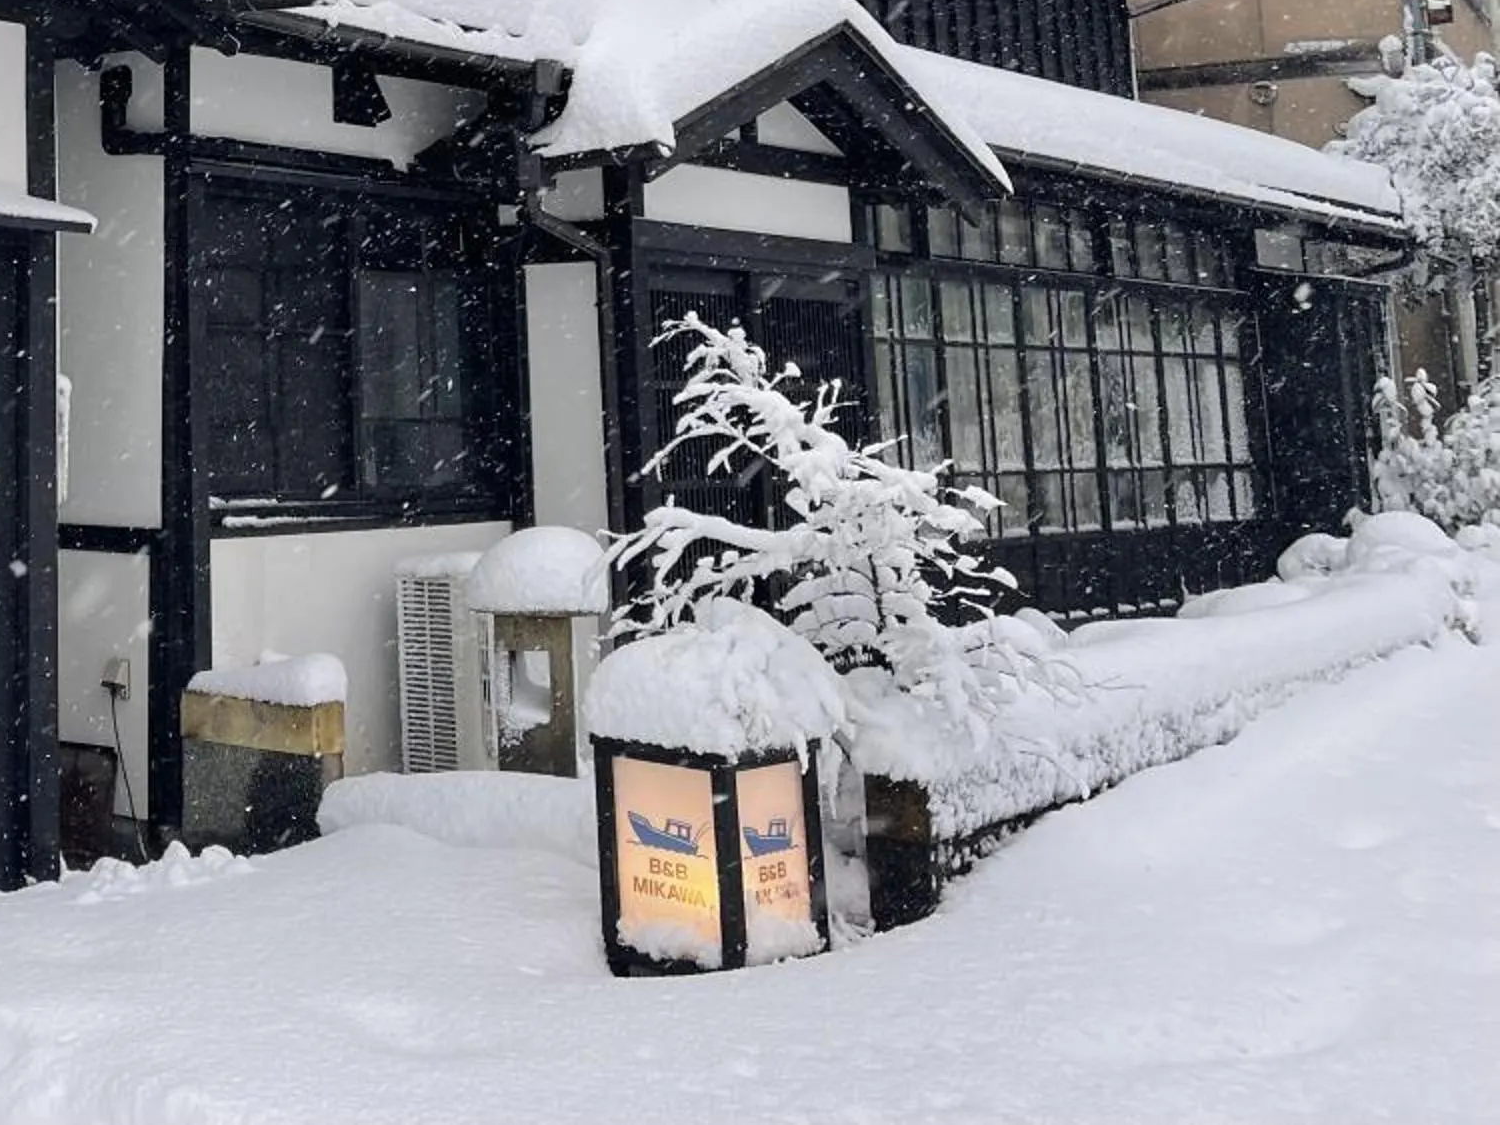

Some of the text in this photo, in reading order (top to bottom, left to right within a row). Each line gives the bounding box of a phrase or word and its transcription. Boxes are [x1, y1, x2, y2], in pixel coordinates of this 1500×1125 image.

[649, 857, 688, 880] B&B
[759, 861, 787, 883] B&B
[633, 876, 707, 908] MIKAWA
